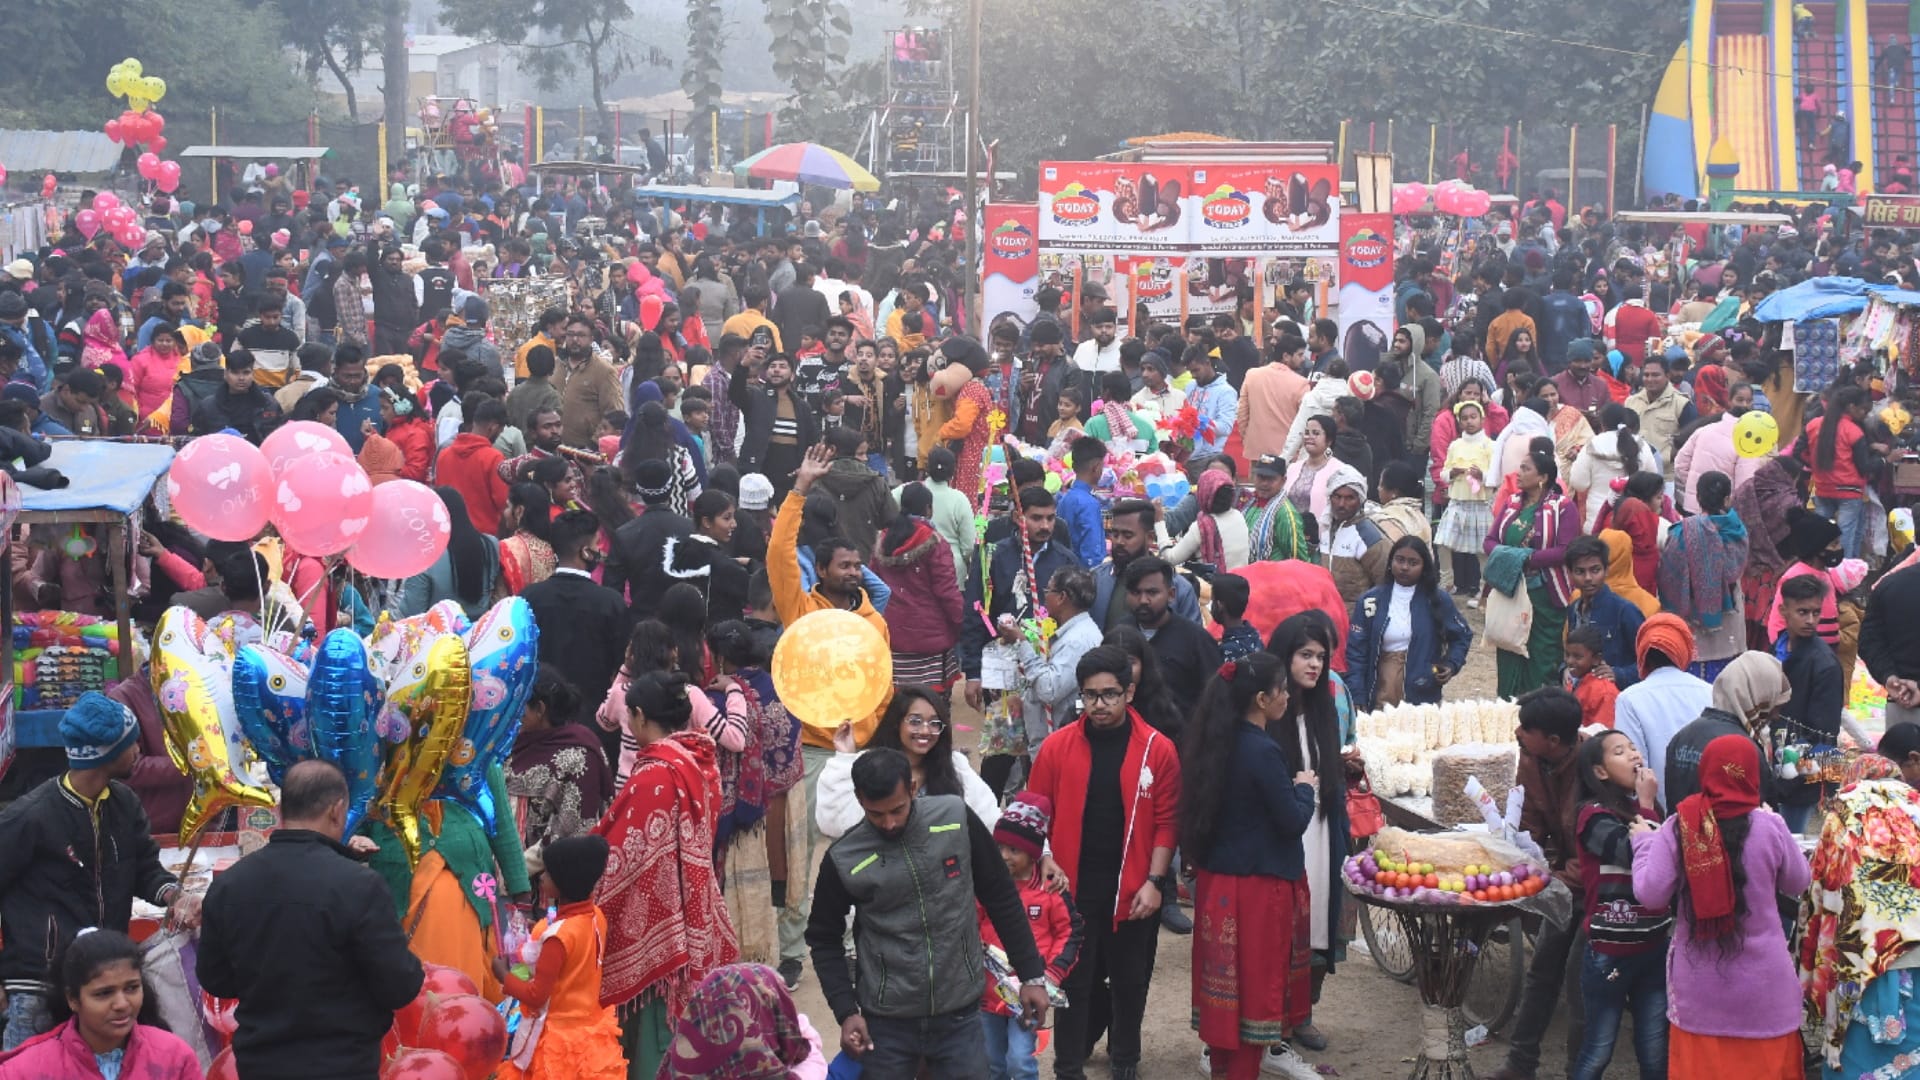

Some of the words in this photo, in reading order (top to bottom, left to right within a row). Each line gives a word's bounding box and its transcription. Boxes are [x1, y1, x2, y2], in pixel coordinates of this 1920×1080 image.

[1056, 202, 1096, 214] TODAY
[1206, 204, 1246, 216] TODAY
[996, 236, 1028, 246] TODAY
[1351, 245, 1382, 256] TODAY
[1363, 597, 1377, 618] 5
